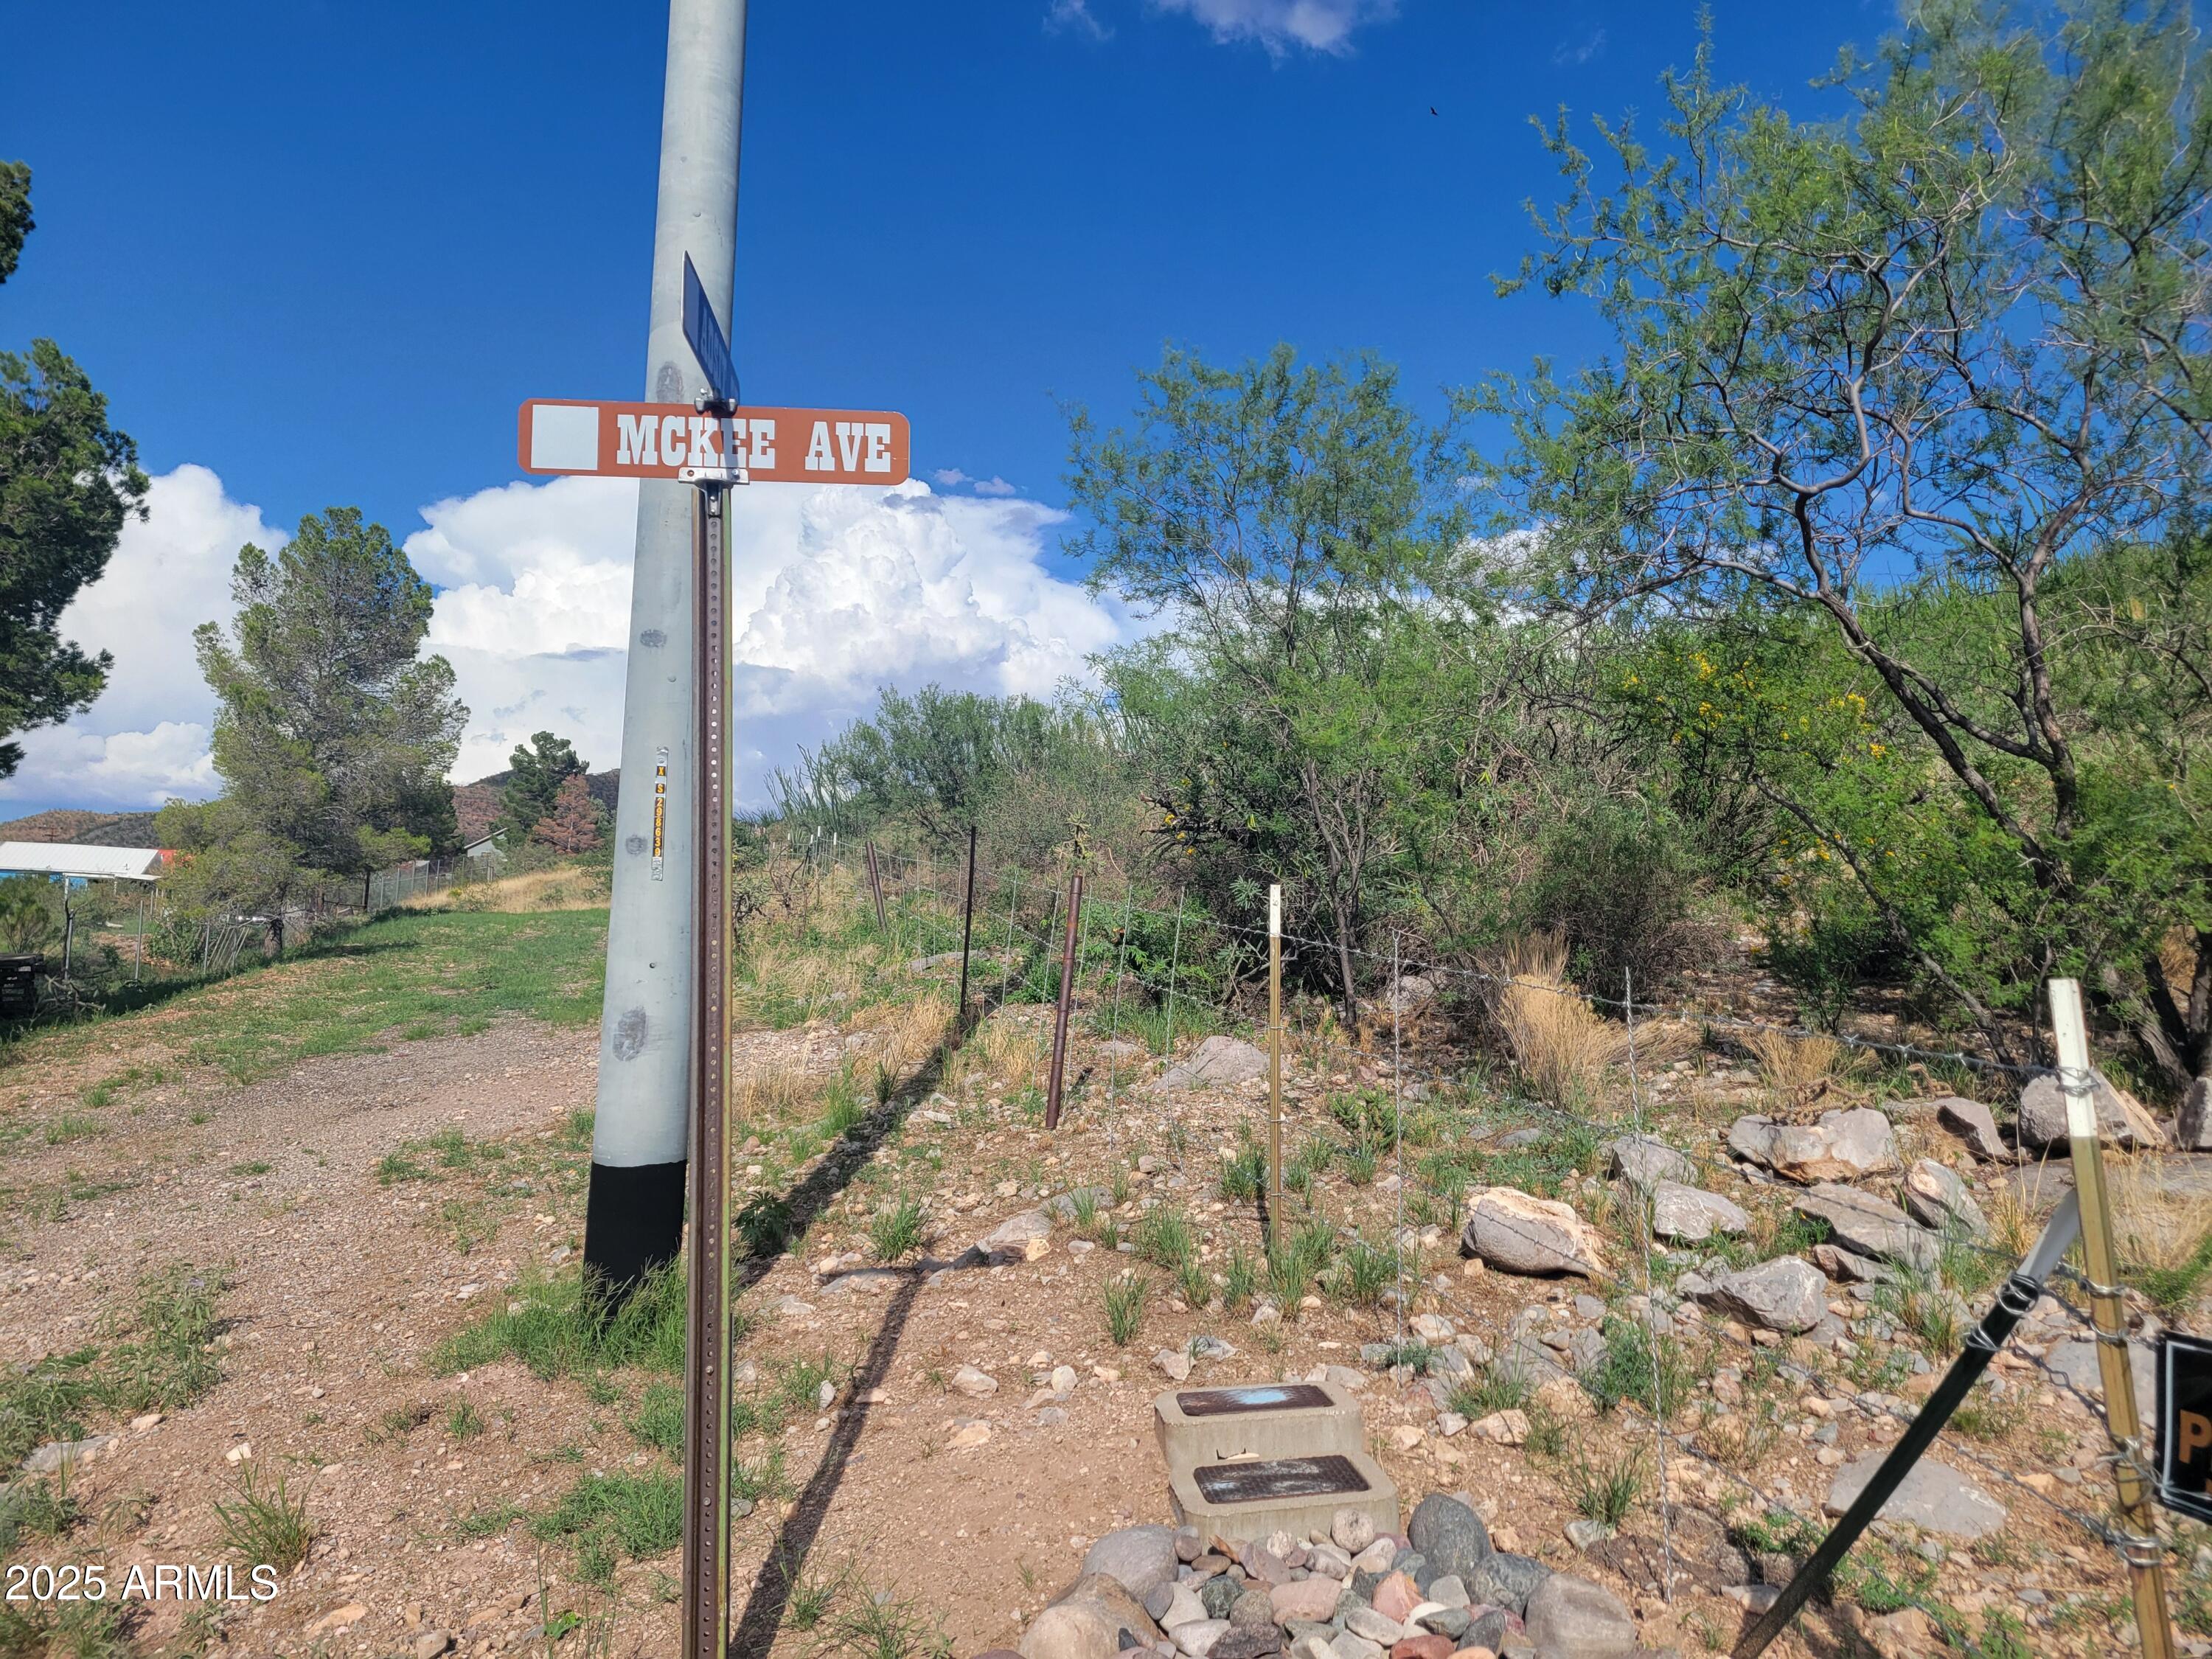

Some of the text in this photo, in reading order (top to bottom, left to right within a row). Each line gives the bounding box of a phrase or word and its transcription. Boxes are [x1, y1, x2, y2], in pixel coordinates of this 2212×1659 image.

[616, 414, 891, 473] MCKEE AVE
[657, 784, 664, 793] S
